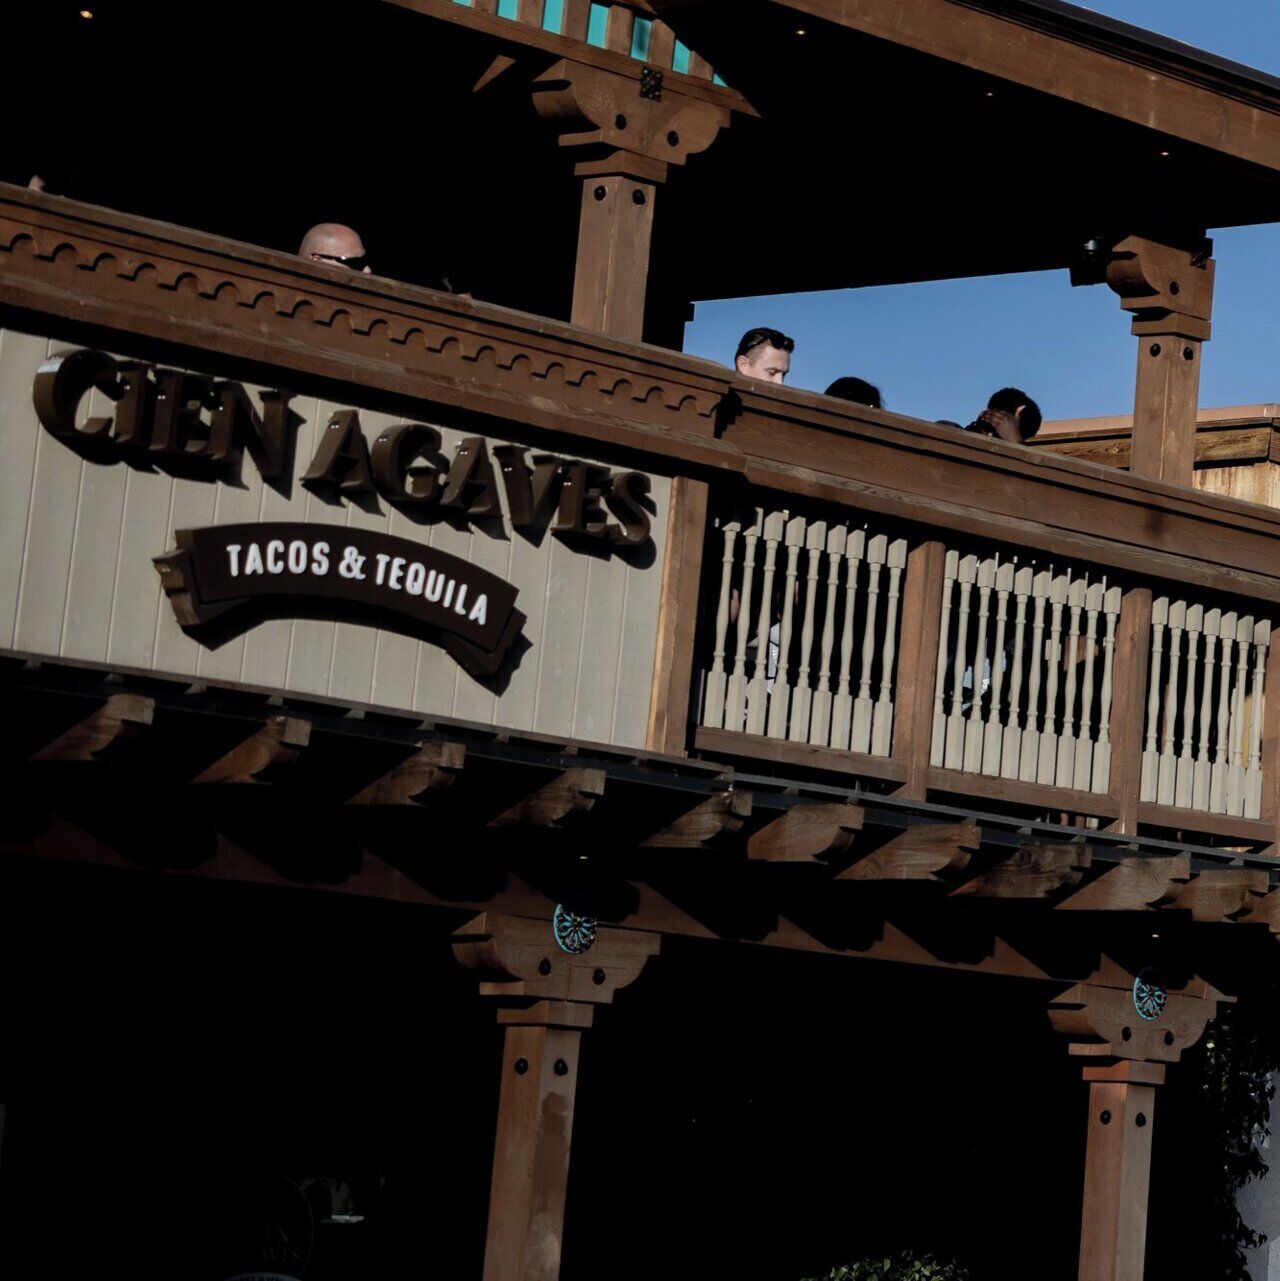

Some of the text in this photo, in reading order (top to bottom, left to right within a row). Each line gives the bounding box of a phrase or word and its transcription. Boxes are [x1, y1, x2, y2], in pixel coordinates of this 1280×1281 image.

[33, 348, 656, 546] CIEN AGAVES
[226, 539, 489, 625] TACOS & TEQUILA
